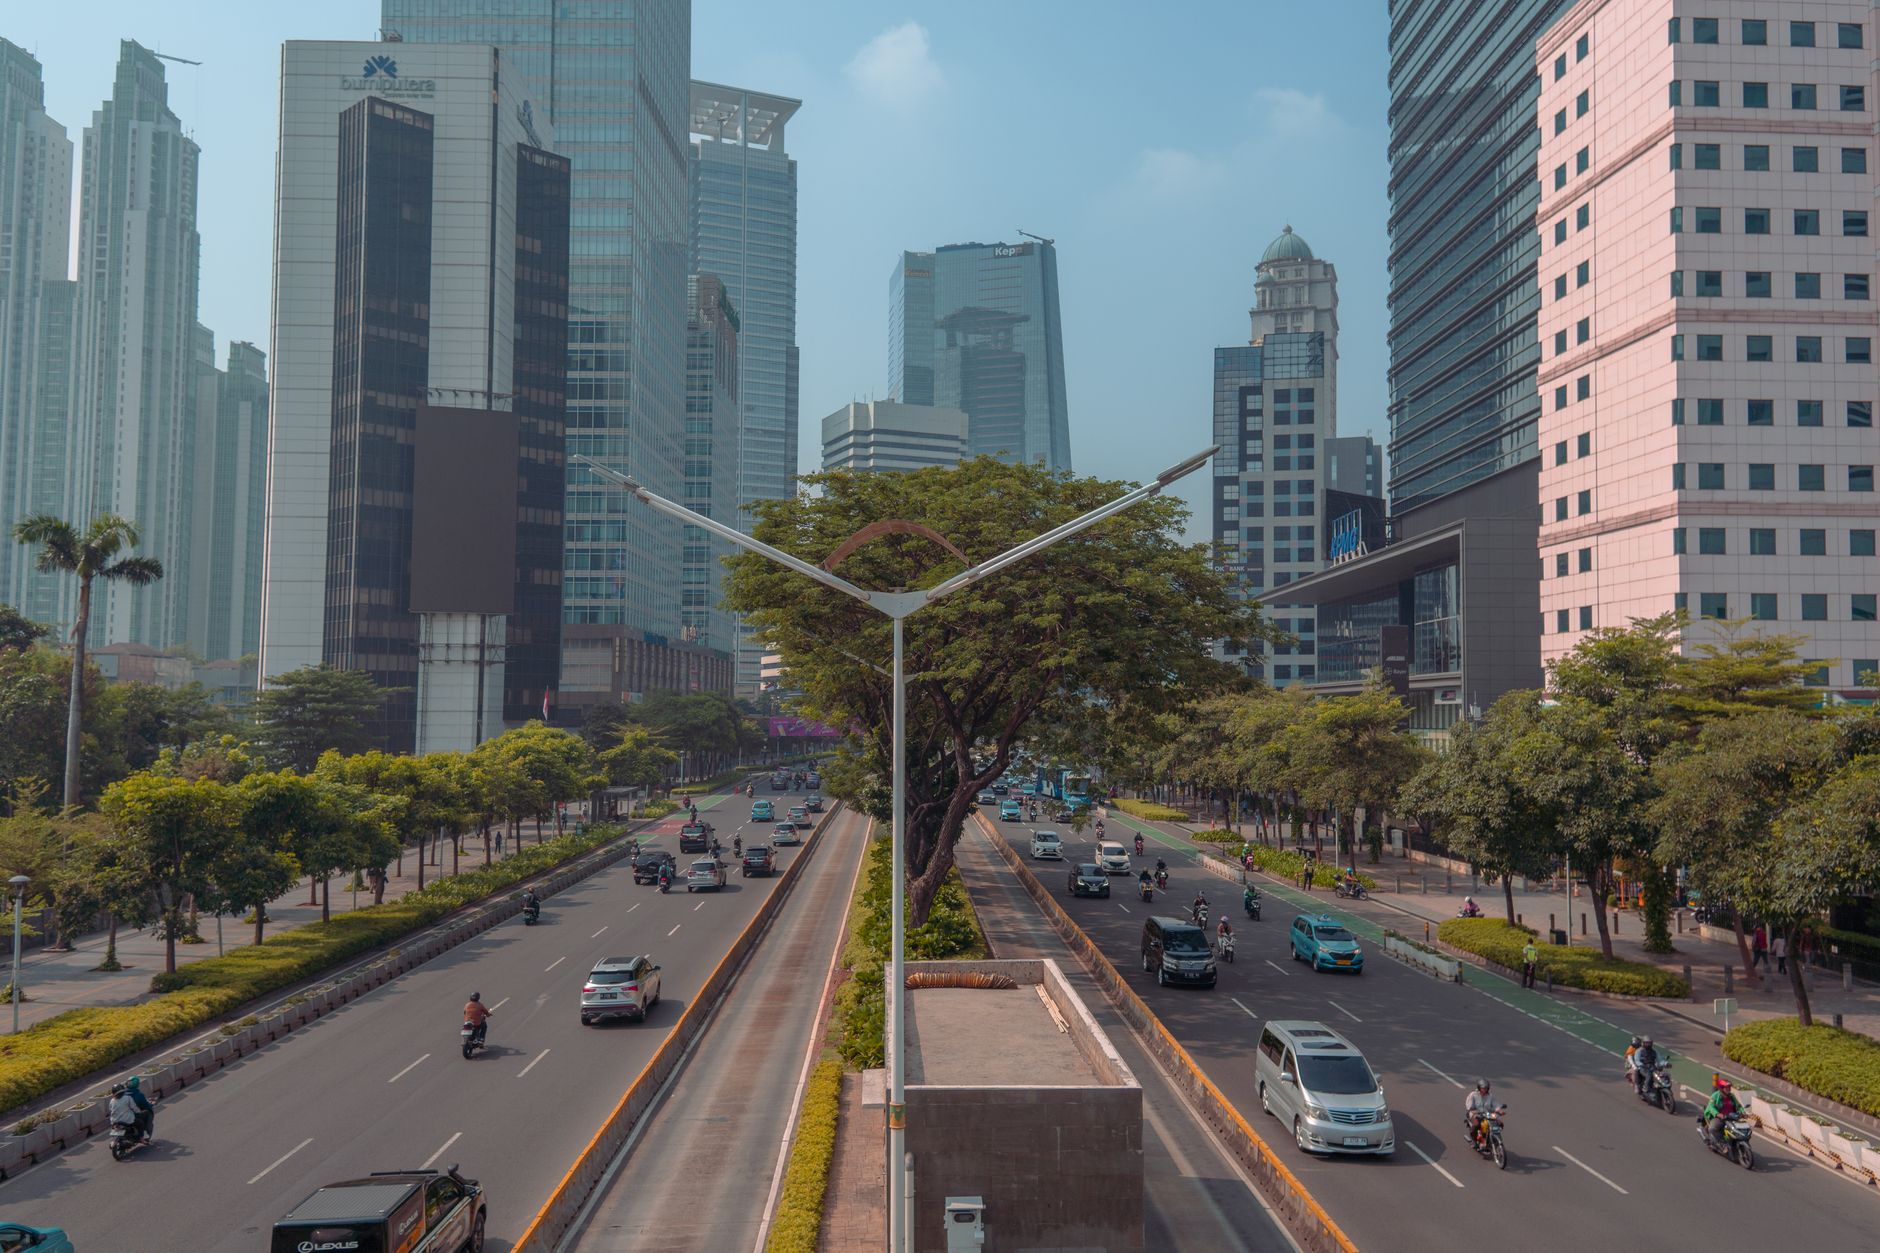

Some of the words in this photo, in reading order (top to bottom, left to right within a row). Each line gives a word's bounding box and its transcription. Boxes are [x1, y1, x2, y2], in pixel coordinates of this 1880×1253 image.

[341, 75, 436, 93] bumiputera
[1331, 527, 1358, 560] KPMG
[314, 1241, 359, 1251] LEXUS
